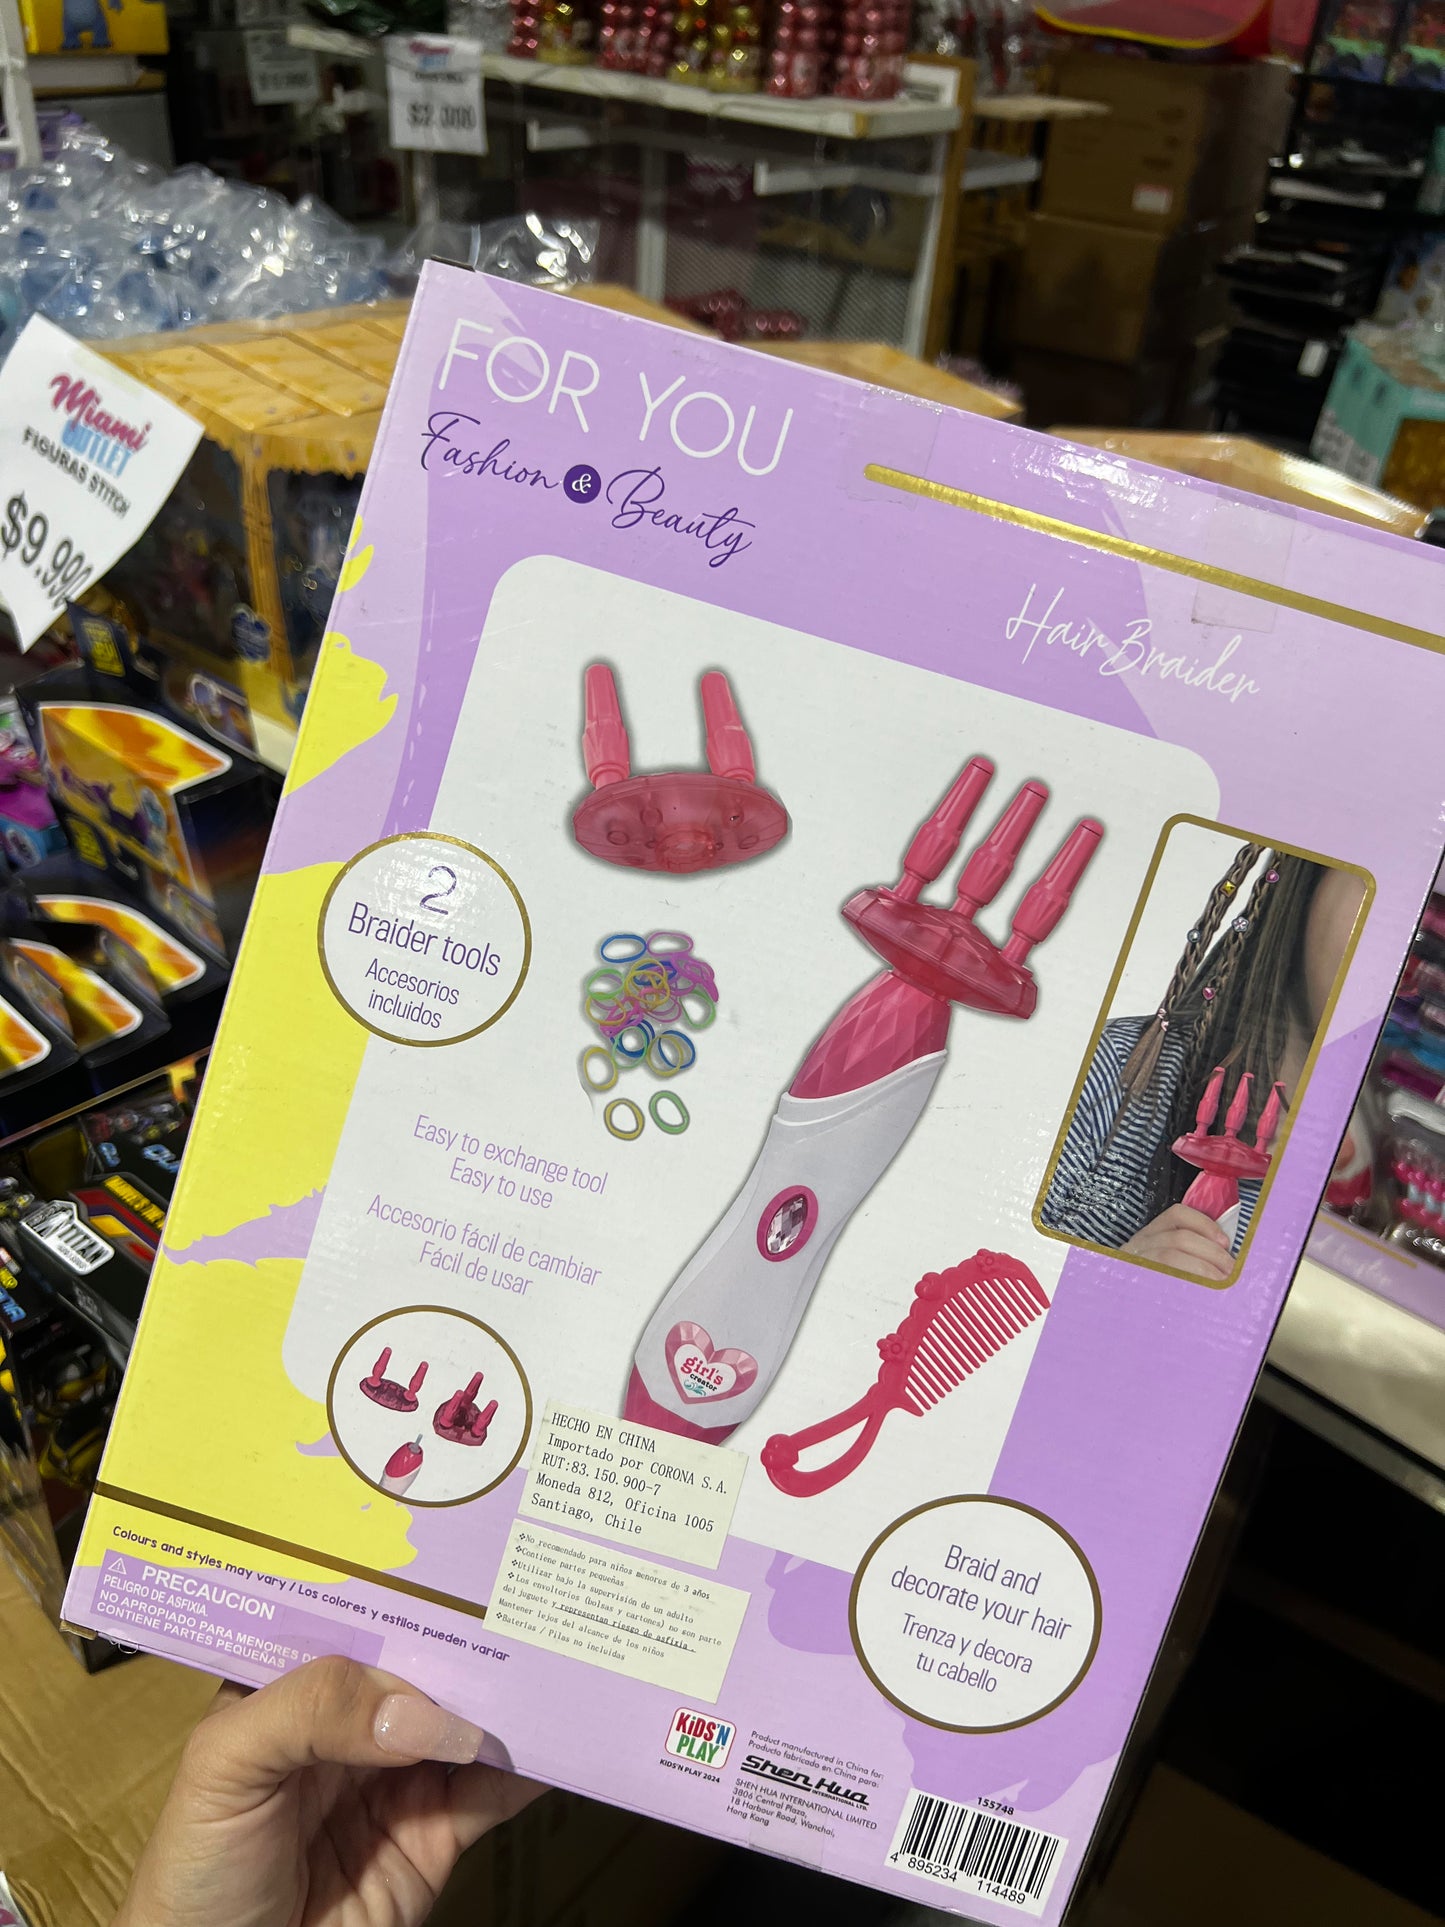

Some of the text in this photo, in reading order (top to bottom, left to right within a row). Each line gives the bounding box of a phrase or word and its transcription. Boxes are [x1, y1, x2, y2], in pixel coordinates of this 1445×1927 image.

[49, 373, 152, 451] Miami
[438, 318, 793, 476] FOR YOU
[22, 427, 130, 519] FIGURAS STITCH
[61, 418, 132, 477] OUTLET
[420, 411, 559, 489] Fashion
[606, 466, 756, 568] Beauty
[1005, 583, 1260, 703] Hair Braider
[419, 865, 457, 915] 2
[348, 901, 501, 976] Braider tools
[364, 958, 460, 1005] Accesorios
[368, 989, 442, 1028] incluidos
[413, 1114, 608, 1195] Easy to exchange tool
[449, 1157, 553, 1209] Easy to use
[366, 1194, 602, 1286] Accesorio fácil de cambiar
[419, 1240, 533, 1296] Fácil de usar
[680, 1356, 723, 1386] girl's
[689, 1373, 717, 1391] creator
[551, 1412, 657, 1453] HECHO EN CHINA
[547, 1433, 727, 1495] Importado por CORONA S.A.
[531, 1492, 642, 1535] Santiago, Chile
[535, 1472, 714, 1533] Moneda 812, Oficina 1005
[141, 1565, 276, 1621] PRECAUCION
[517, 1561, 694, 1624] Utilizar bajo supervisión de un adulto
[521, 1547, 625, 1587] Contiene partes pequeñas
[538, 1539, 711, 1600] recomendado para niños menores de años
[944, 1544, 1042, 1596] Braid and
[102, 1573, 209, 1617] PELIGRO DE ASFIXIA.
[112, 1525, 511, 1662] Colours and styles may vary Los colores y estilos pueden variar
[502, 1584, 516, 1595] del
[518, 1588, 549, 1605] juguete
[560, 1603, 609, 1624] representan
[612, 1619, 640, 1635] riesgo
[515, 1574, 722, 1647] Los envoltorios (bolsas cartones) no son parte
[891, 1565, 1072, 1640] decorate your hair
[96, 1602, 287, 1669] CONTIENE PARTES PEQUEÑAS
[99, 1589, 299, 1661] NO APROPIADO PARA MENORES
[498, 1597, 665, 1659] Mantener lejos del alcance de los niños
[548, 1629, 626, 1661] Pilas incluidas
[902, 1612, 1033, 1674] Trenza y decora
[916, 1652, 997, 1693] tu cabello
[660, 1758, 721, 1783] KIDS'N PLAY 2024
[676, 1733, 720, 1764] PLAY
[748, 1740, 880, 1789] Producto fabricado en China para:
[751, 1730, 869, 1775] Product manufactured in China
[732, 1787, 808, 1819] 3806 Central Plaza,
[735, 1778, 878, 1830] SHEN HUA INTERNATIONAL LIMITED
[740, 1754, 870, 1806] Shen Hua
[811, 1789, 855, 1807] INTERNATIONAL
[976, 1796, 1015, 1816] 155748
[726, 1806, 770, 1826] Hong Kong
[731, 1796, 835, 1838] 18 Harbour Road, Wanchai,
[889, 1851, 1026, 1905] 4 895234 114489
